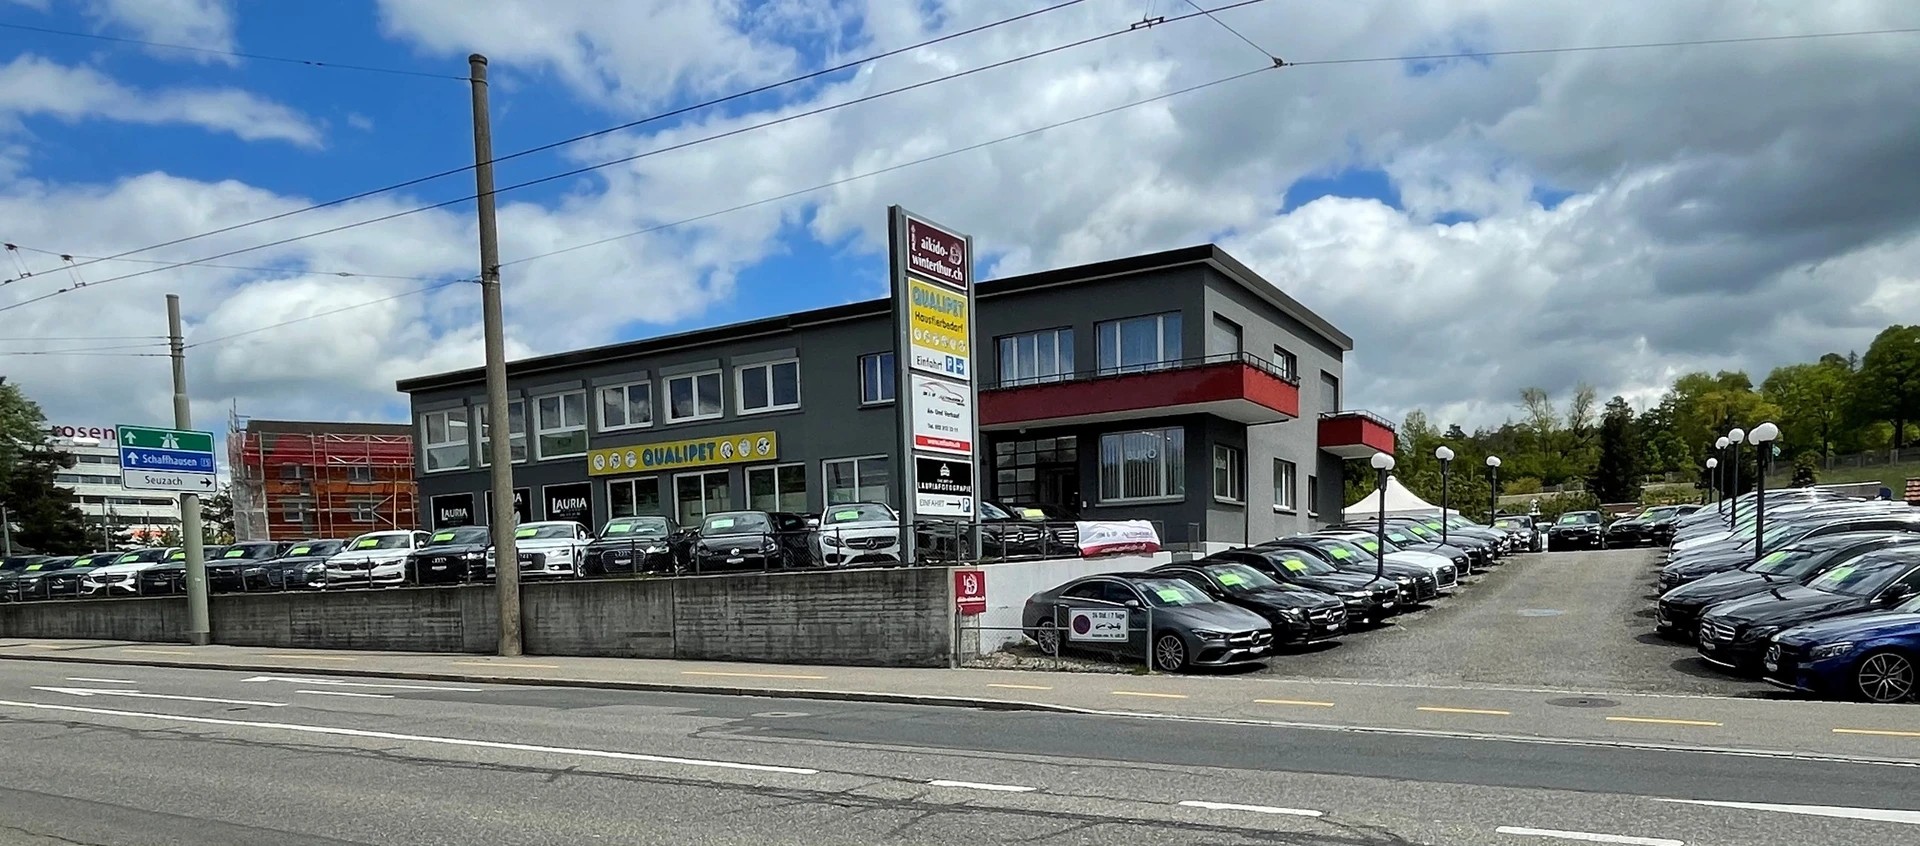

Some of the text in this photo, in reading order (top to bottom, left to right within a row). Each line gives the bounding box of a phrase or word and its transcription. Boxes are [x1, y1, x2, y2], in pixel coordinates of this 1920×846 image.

[921, 236, 948, 256] aikido-
[911, 253, 963, 281] winterthur.ch
[912, 286, 964, 318] QUALIPET
[914, 311, 963, 333] Haustierbedarf
[916, 355, 943, 370] Einfahrt
[52, 425, 115, 440] rosen
[142, 454, 197, 467] Schaffhausen
[642, 442, 717, 467] QUALIPET
[145, 475, 183, 486] Seuzach
[552, 497, 587, 513] LAURIA
[920, 499, 945, 507] EINFAHRT
[441, 508, 468, 521] LAURIA
